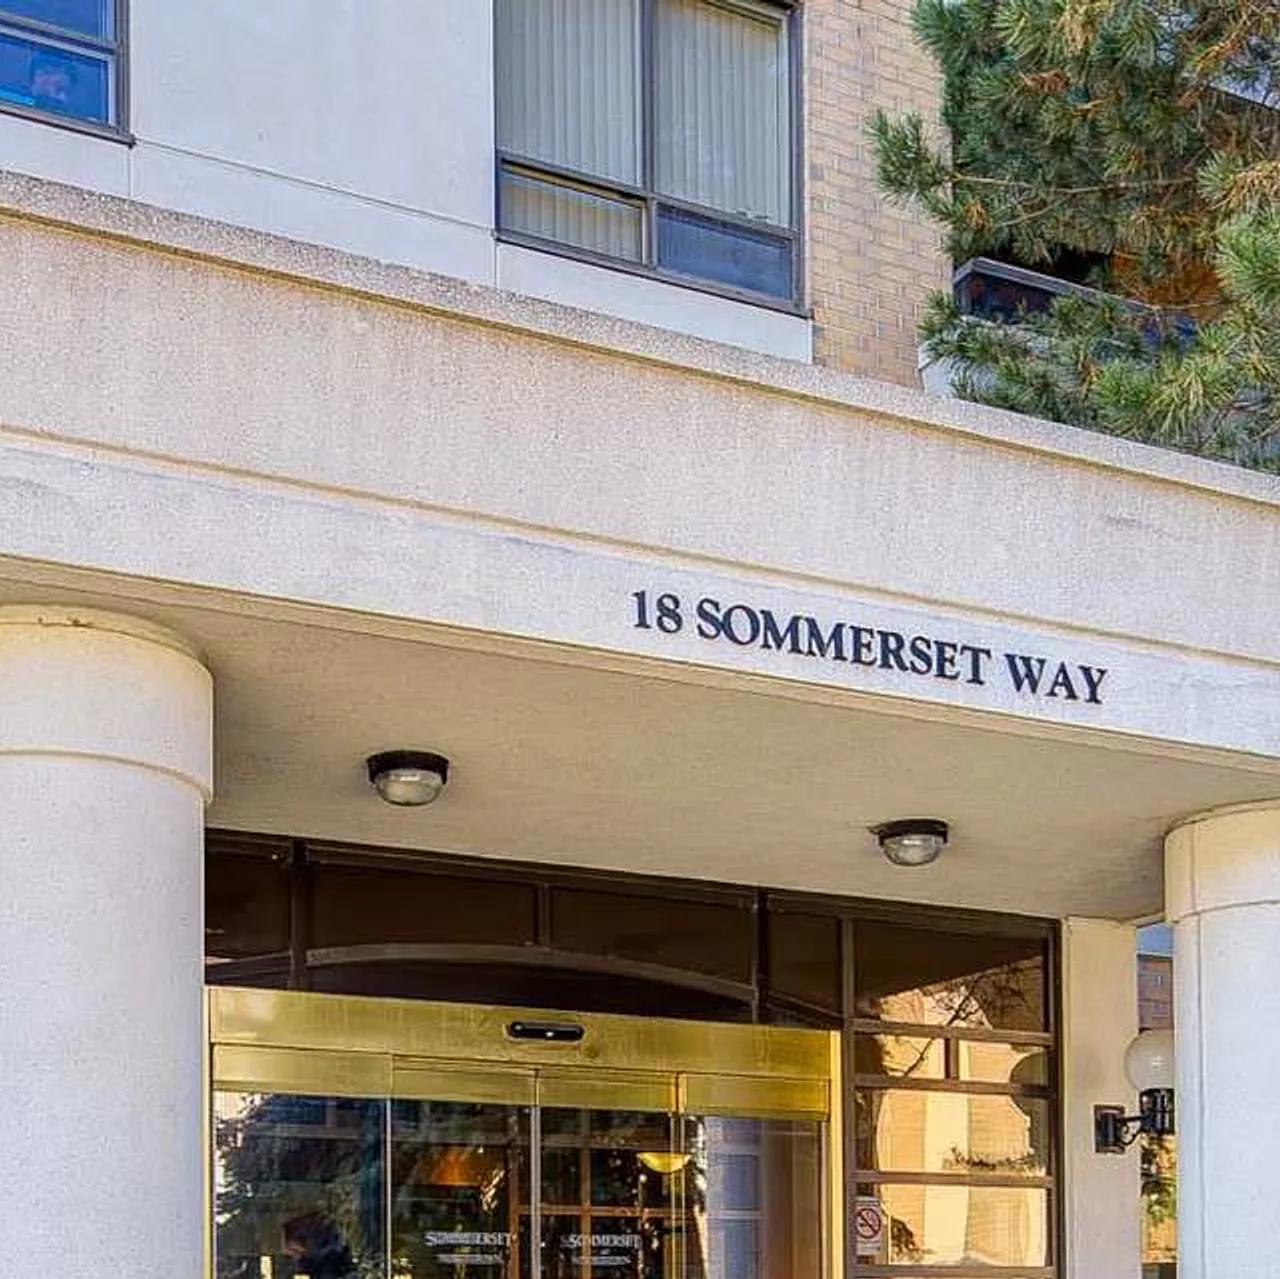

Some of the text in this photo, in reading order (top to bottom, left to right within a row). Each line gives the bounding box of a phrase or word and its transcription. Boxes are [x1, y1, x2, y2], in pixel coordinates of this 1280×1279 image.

[632, 589, 1107, 704] 18 SOMMERSET WAY
